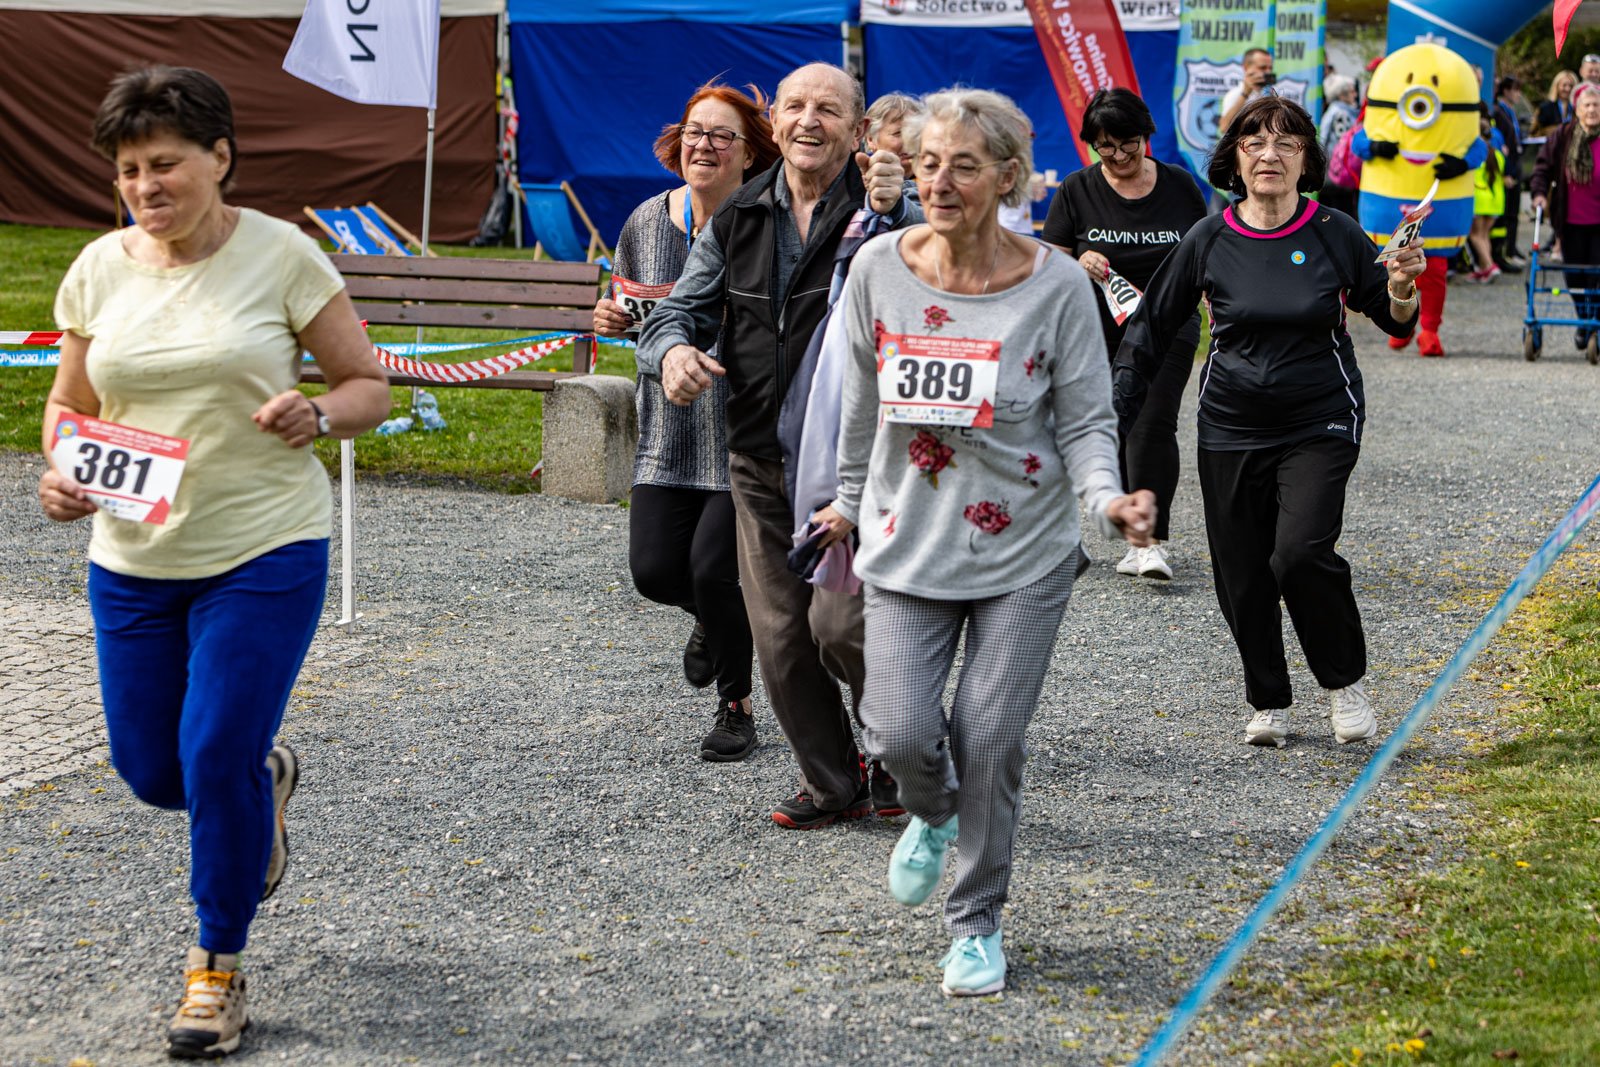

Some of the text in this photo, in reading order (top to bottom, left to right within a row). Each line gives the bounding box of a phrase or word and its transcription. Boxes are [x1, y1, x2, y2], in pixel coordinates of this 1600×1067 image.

[1087, 228, 1181, 244] CALVIN KLEIN
[897, 358, 973, 402] 389
[74, 442, 153, 495] 381
